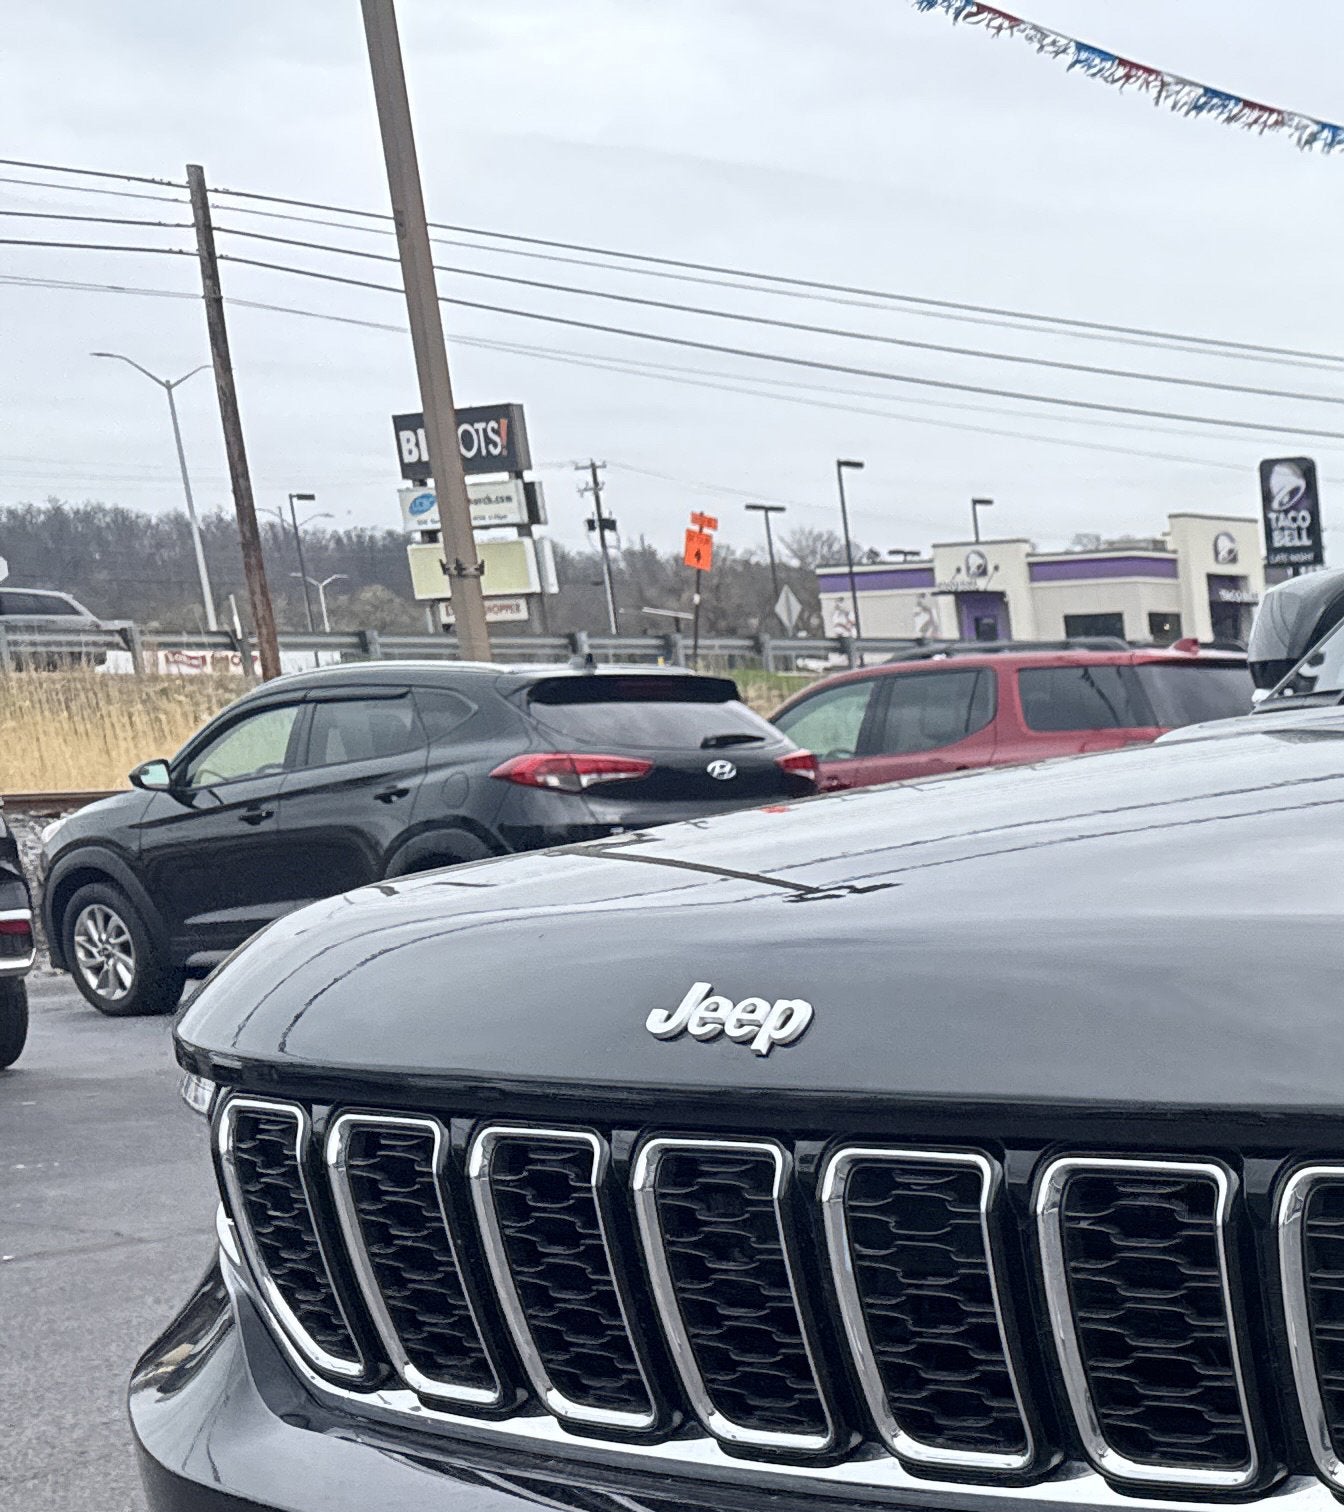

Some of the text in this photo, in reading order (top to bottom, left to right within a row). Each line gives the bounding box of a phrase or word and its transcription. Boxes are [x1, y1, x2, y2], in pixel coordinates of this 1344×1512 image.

[399, 418, 508, 464] BI OTS!
[1267, 509, 1312, 530] TACO
[1271, 528, 1313, 548] BELL
[645, 981, 814, 1057] Jeep
